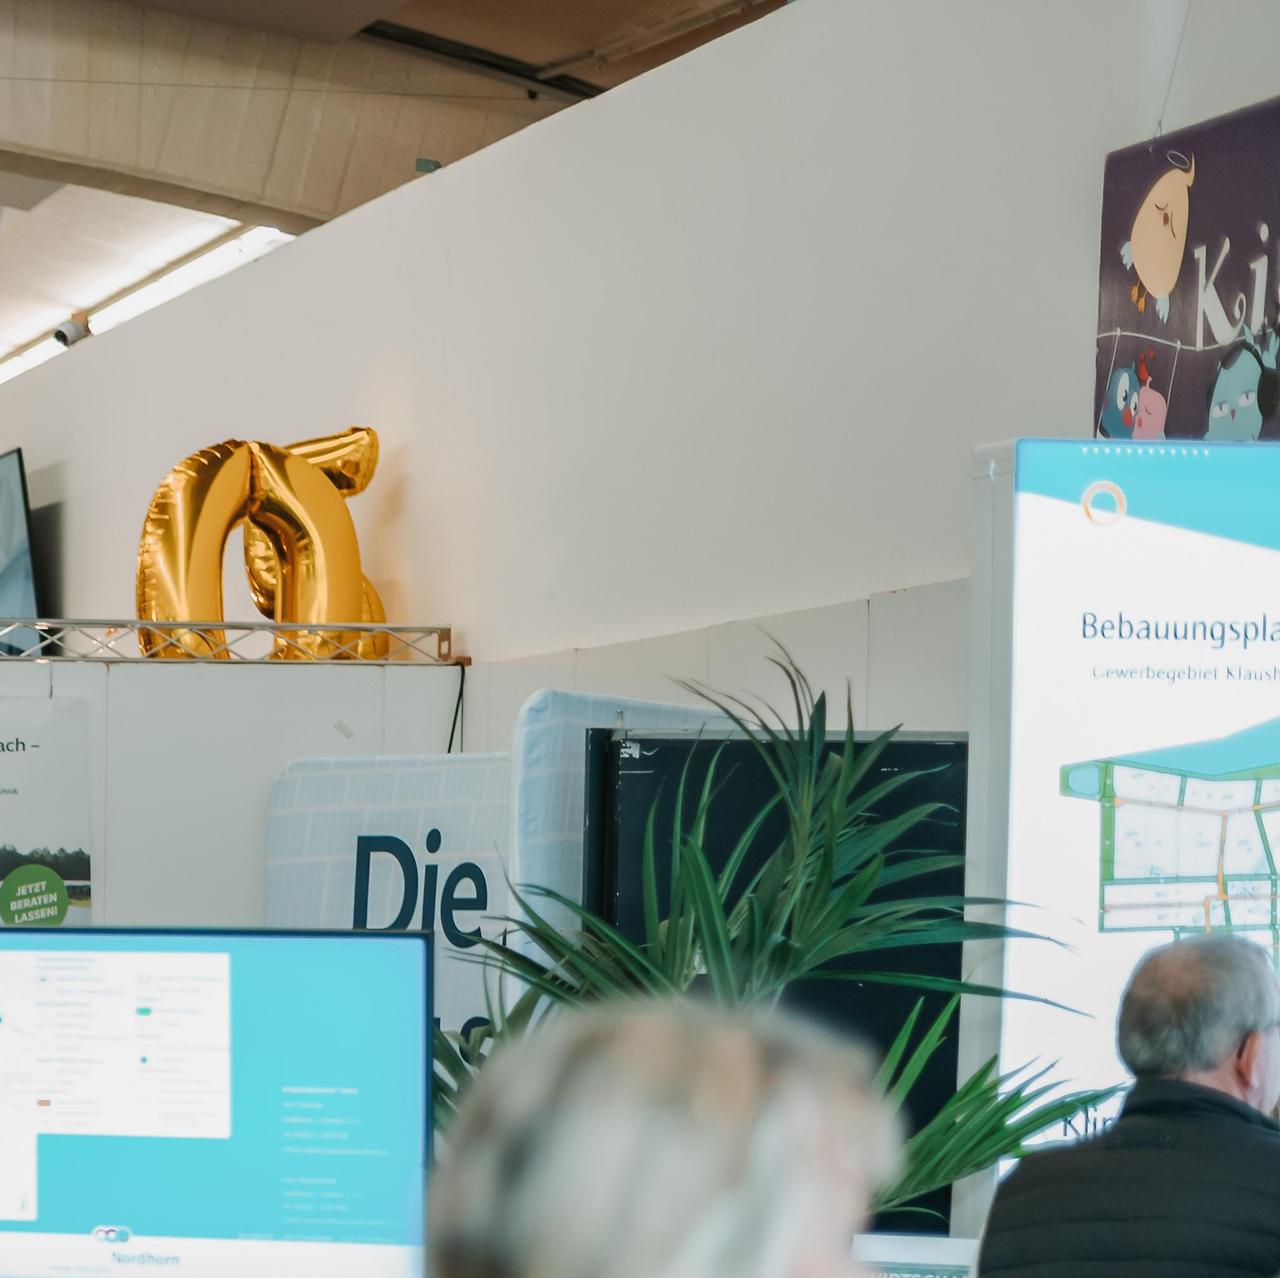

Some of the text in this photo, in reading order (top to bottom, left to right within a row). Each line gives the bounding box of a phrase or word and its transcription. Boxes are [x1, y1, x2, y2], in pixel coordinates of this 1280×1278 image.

[1194, 223, 1280, 351] Ki
[16, 881, 47, 896] JETZT
[352, 828, 488, 948] Die
[10, 892, 57, 911] BERATEN
[15, 906, 58, 923] LASSEN!
